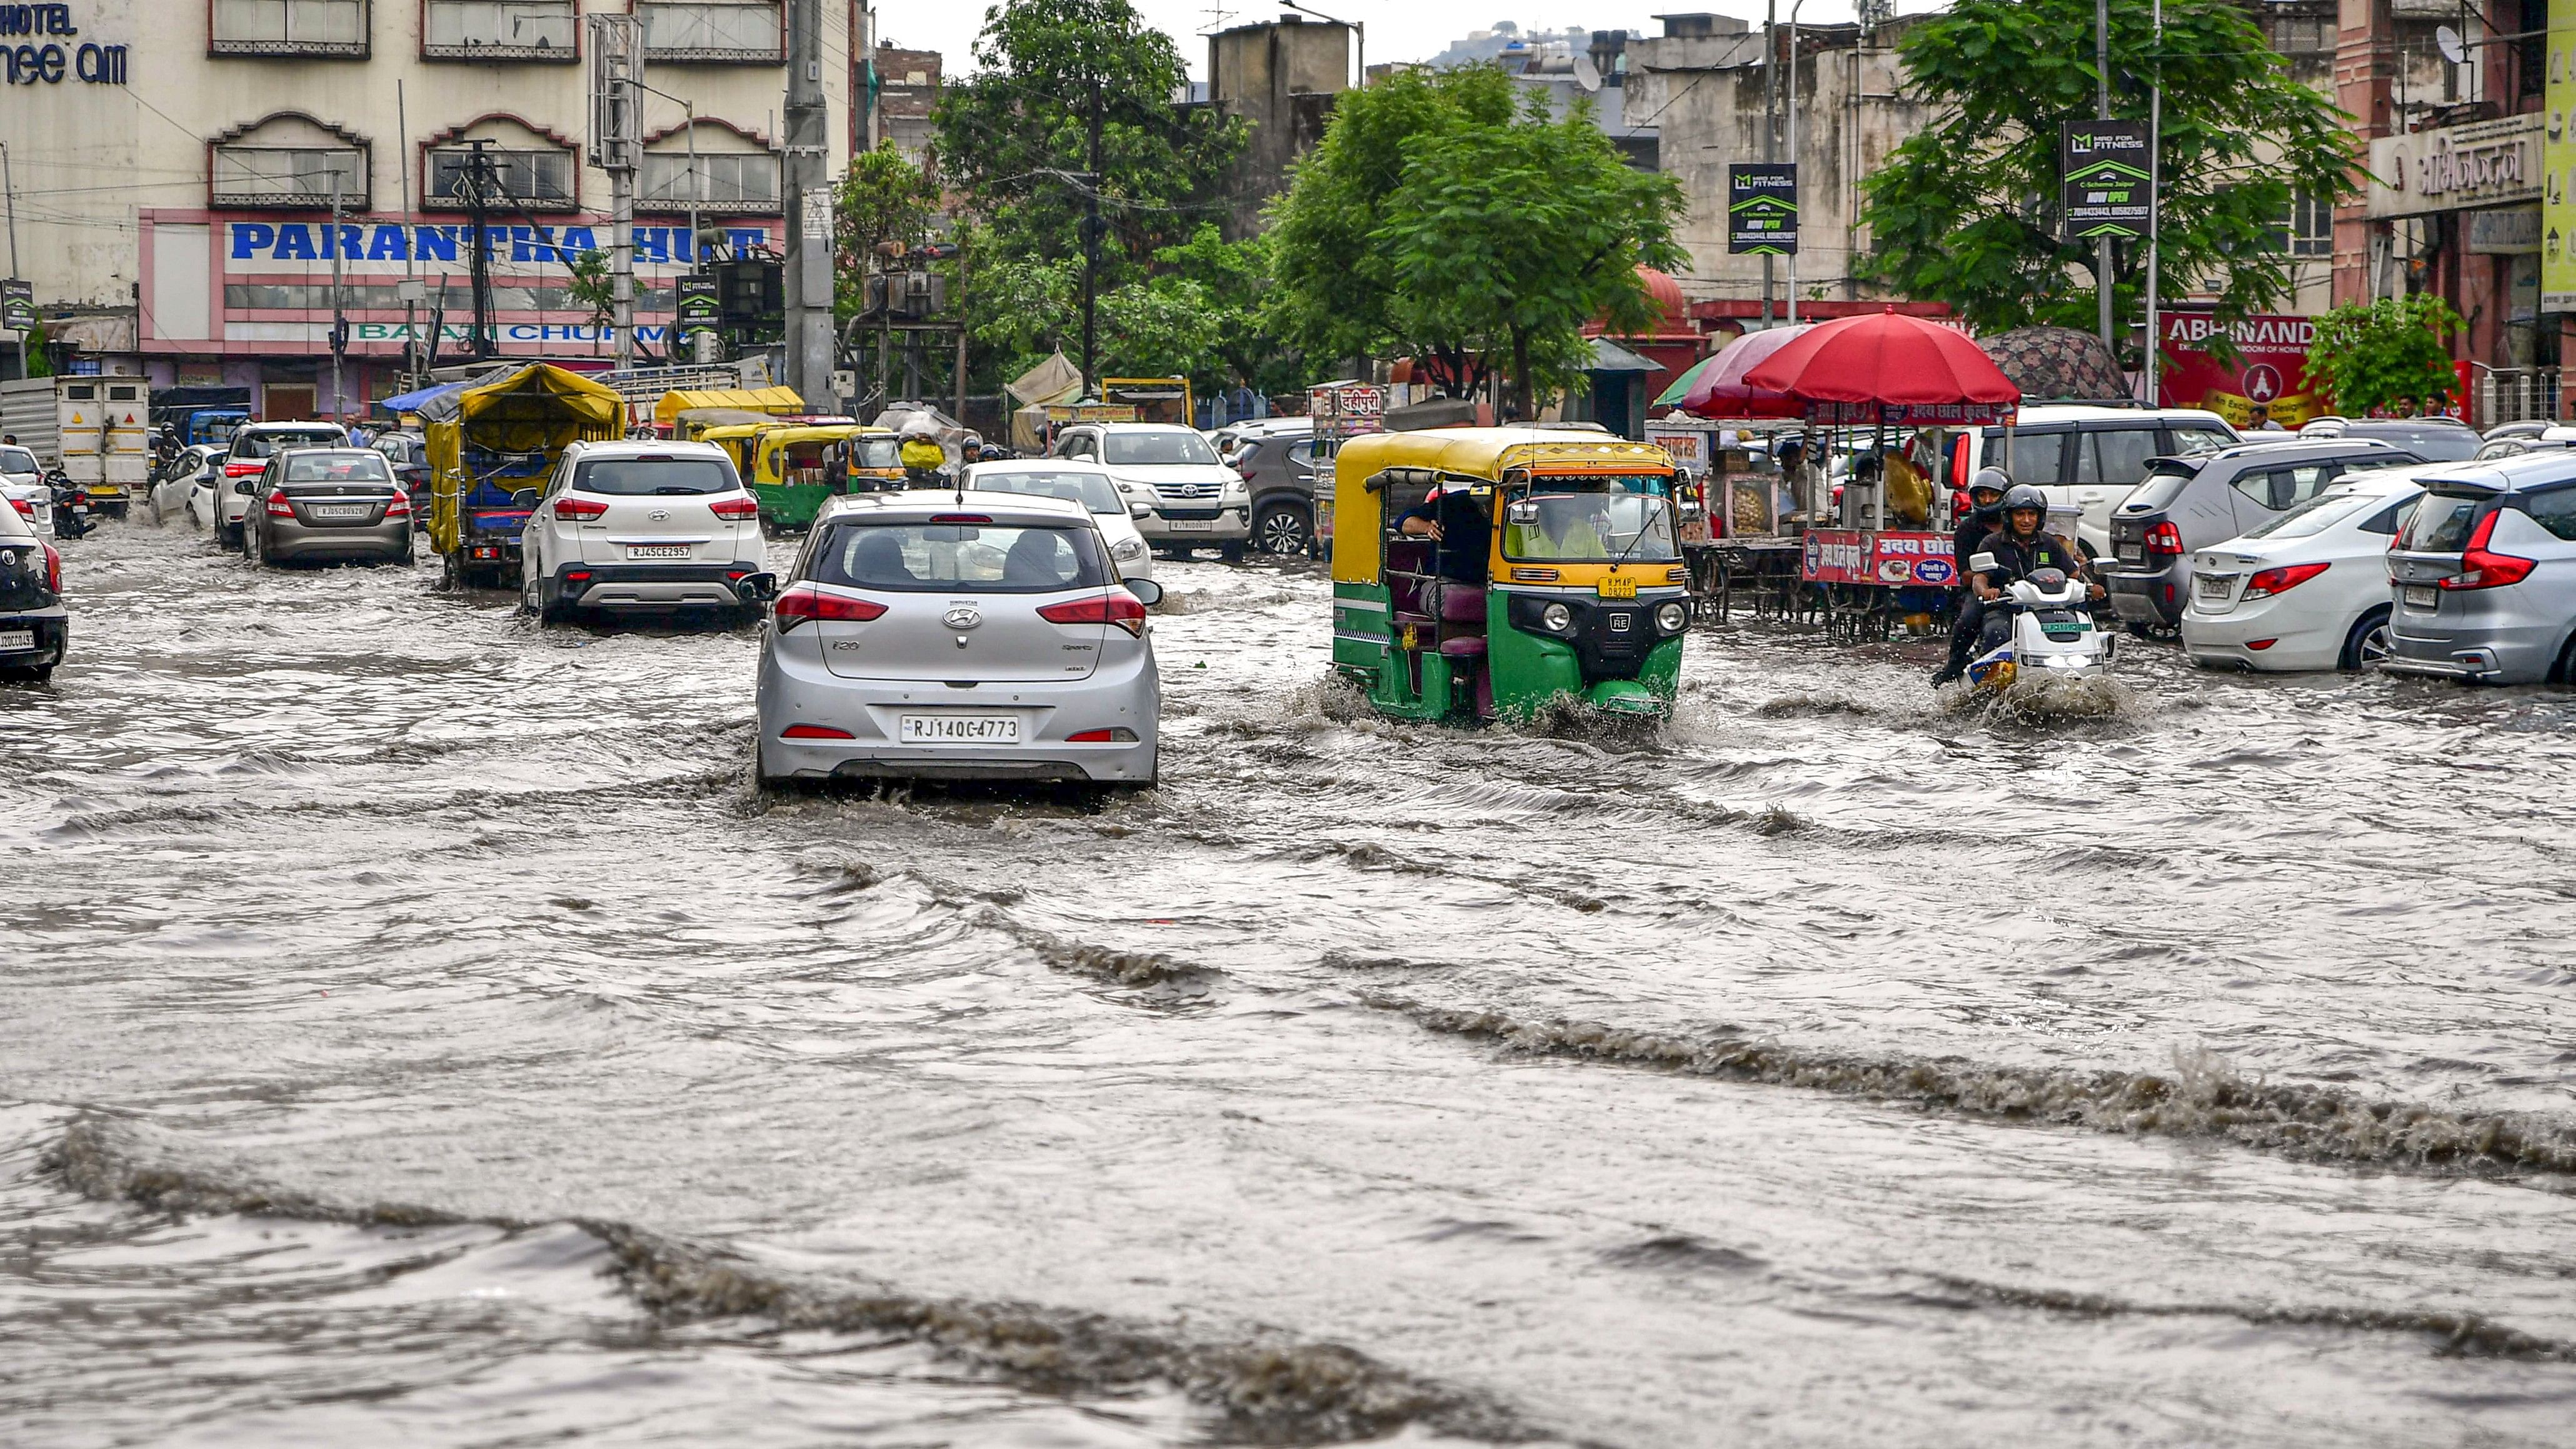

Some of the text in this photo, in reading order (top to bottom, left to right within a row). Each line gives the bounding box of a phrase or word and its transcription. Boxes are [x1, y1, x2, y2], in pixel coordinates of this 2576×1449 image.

[0, 4, 78, 35] HOTEL
[2095, 141, 2144, 149] FITNESS
[2108, 191, 2130, 203] OPEN
[231, 223, 599, 262] PARANTHA
[1342, 391, 1379, 413] दहीपुरी
[633, 546, 689, 557] RJ45CE2957
[1878, 538, 1920, 554] उदय
[1613, 619, 1628, 628] RE
[832, 640, 860, 650] i20
